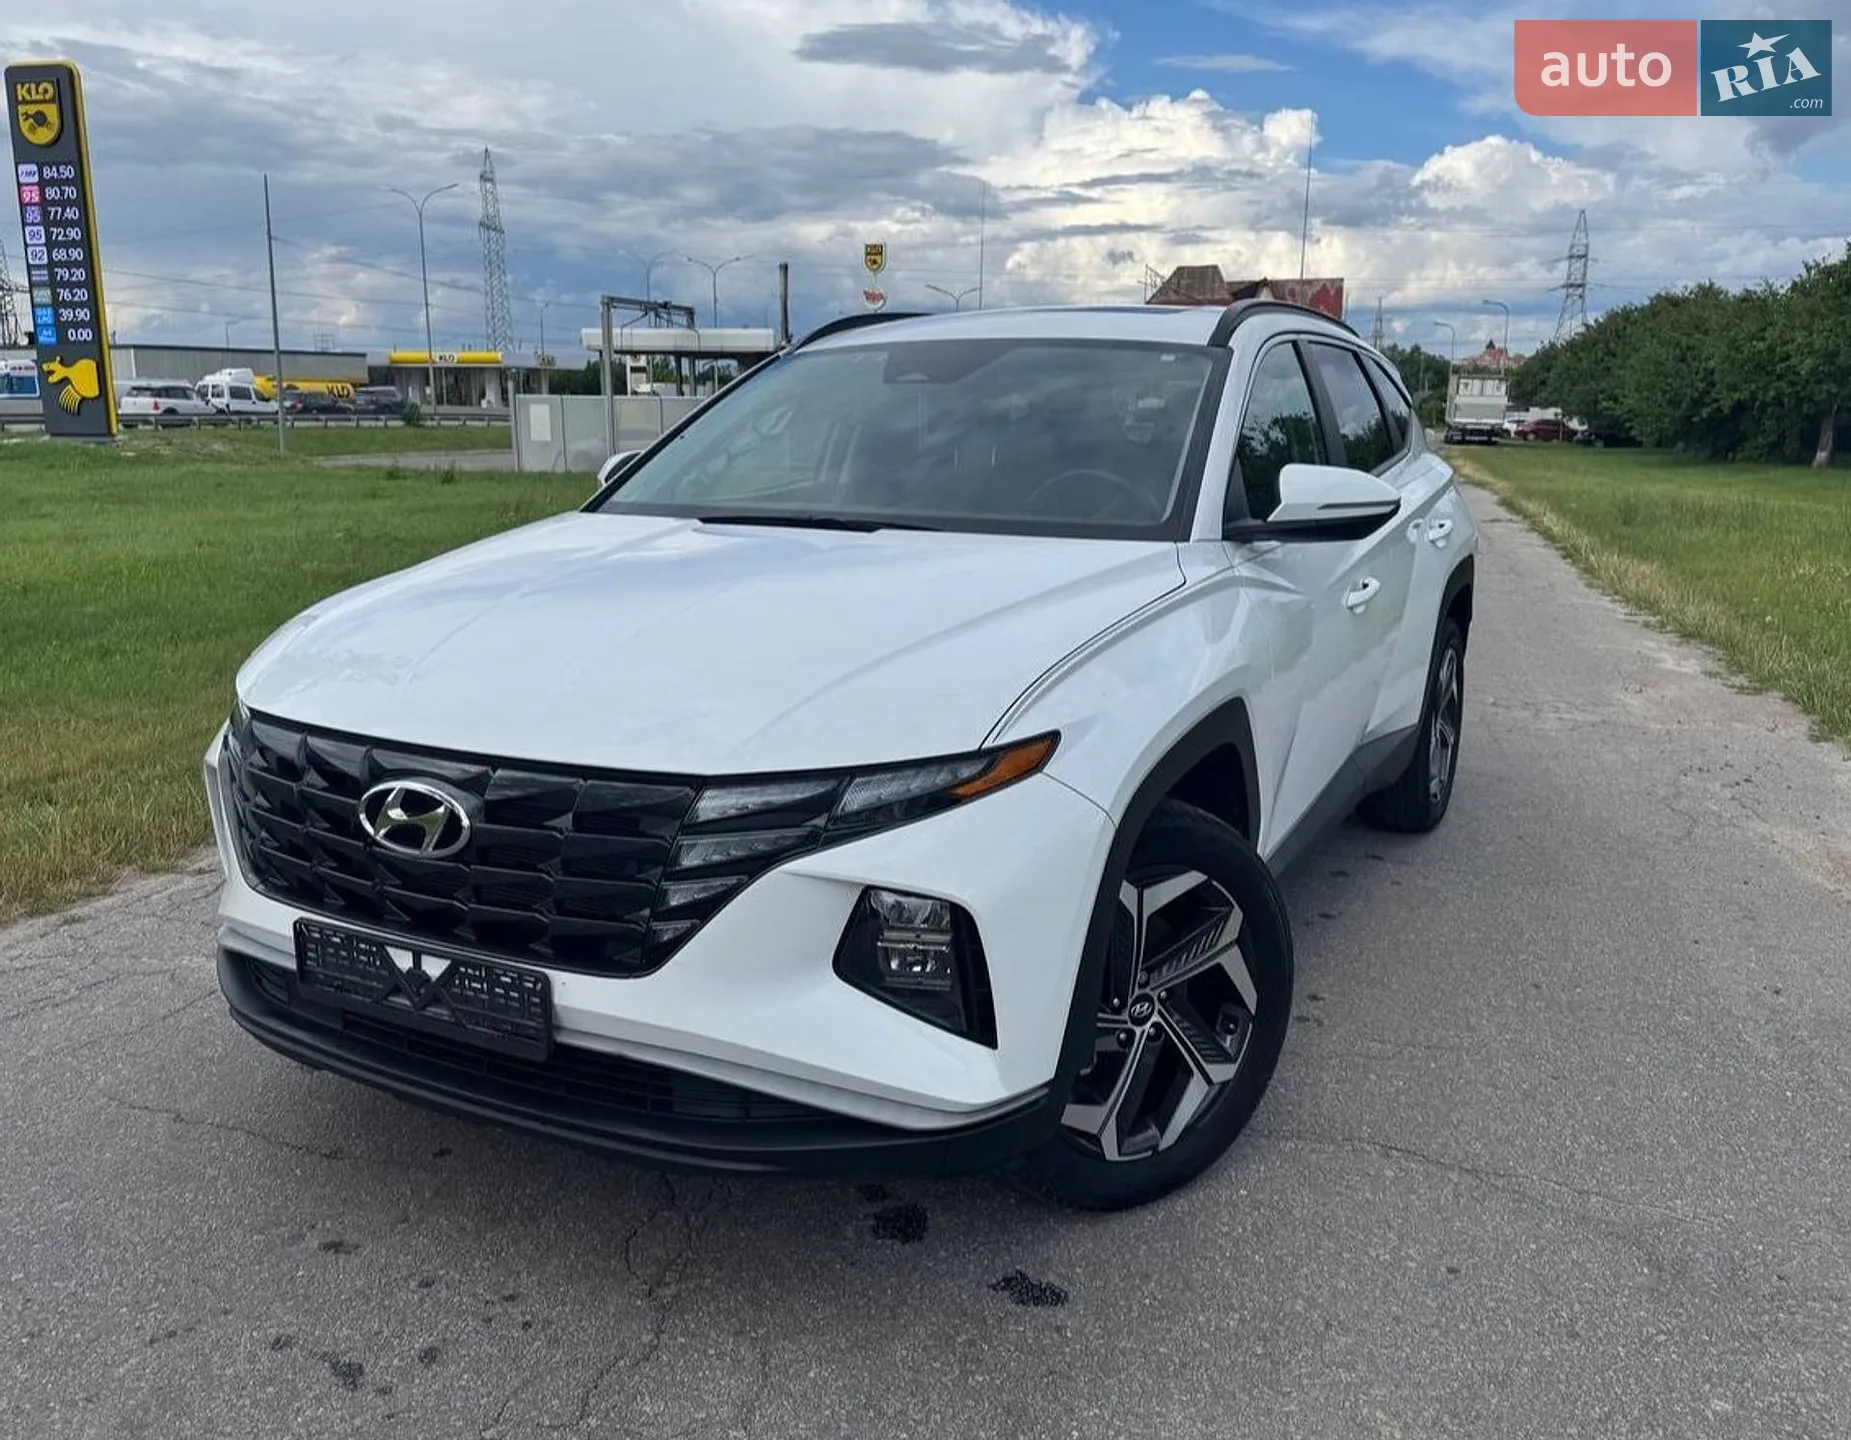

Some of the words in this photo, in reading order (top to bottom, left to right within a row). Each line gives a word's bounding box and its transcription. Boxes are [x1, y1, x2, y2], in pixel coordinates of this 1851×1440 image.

[16, 82, 55, 101] KLO
[42, 165, 75, 180] 84.50
[45, 186, 77, 200] 80.70
[47, 206, 79, 220] 77.40
[28, 228, 43, 241] 95
[50, 227, 82, 240] 72.90
[30, 248, 46, 262] 92
[52, 247, 84, 261] 68.90
[54, 267, 86, 281] 79.20
[56, 288, 88, 301] 76.20
[59, 308, 90, 322] 39.90
[67, 328, 93, 342] 0.00
[325, 384, 351, 399] KLO
